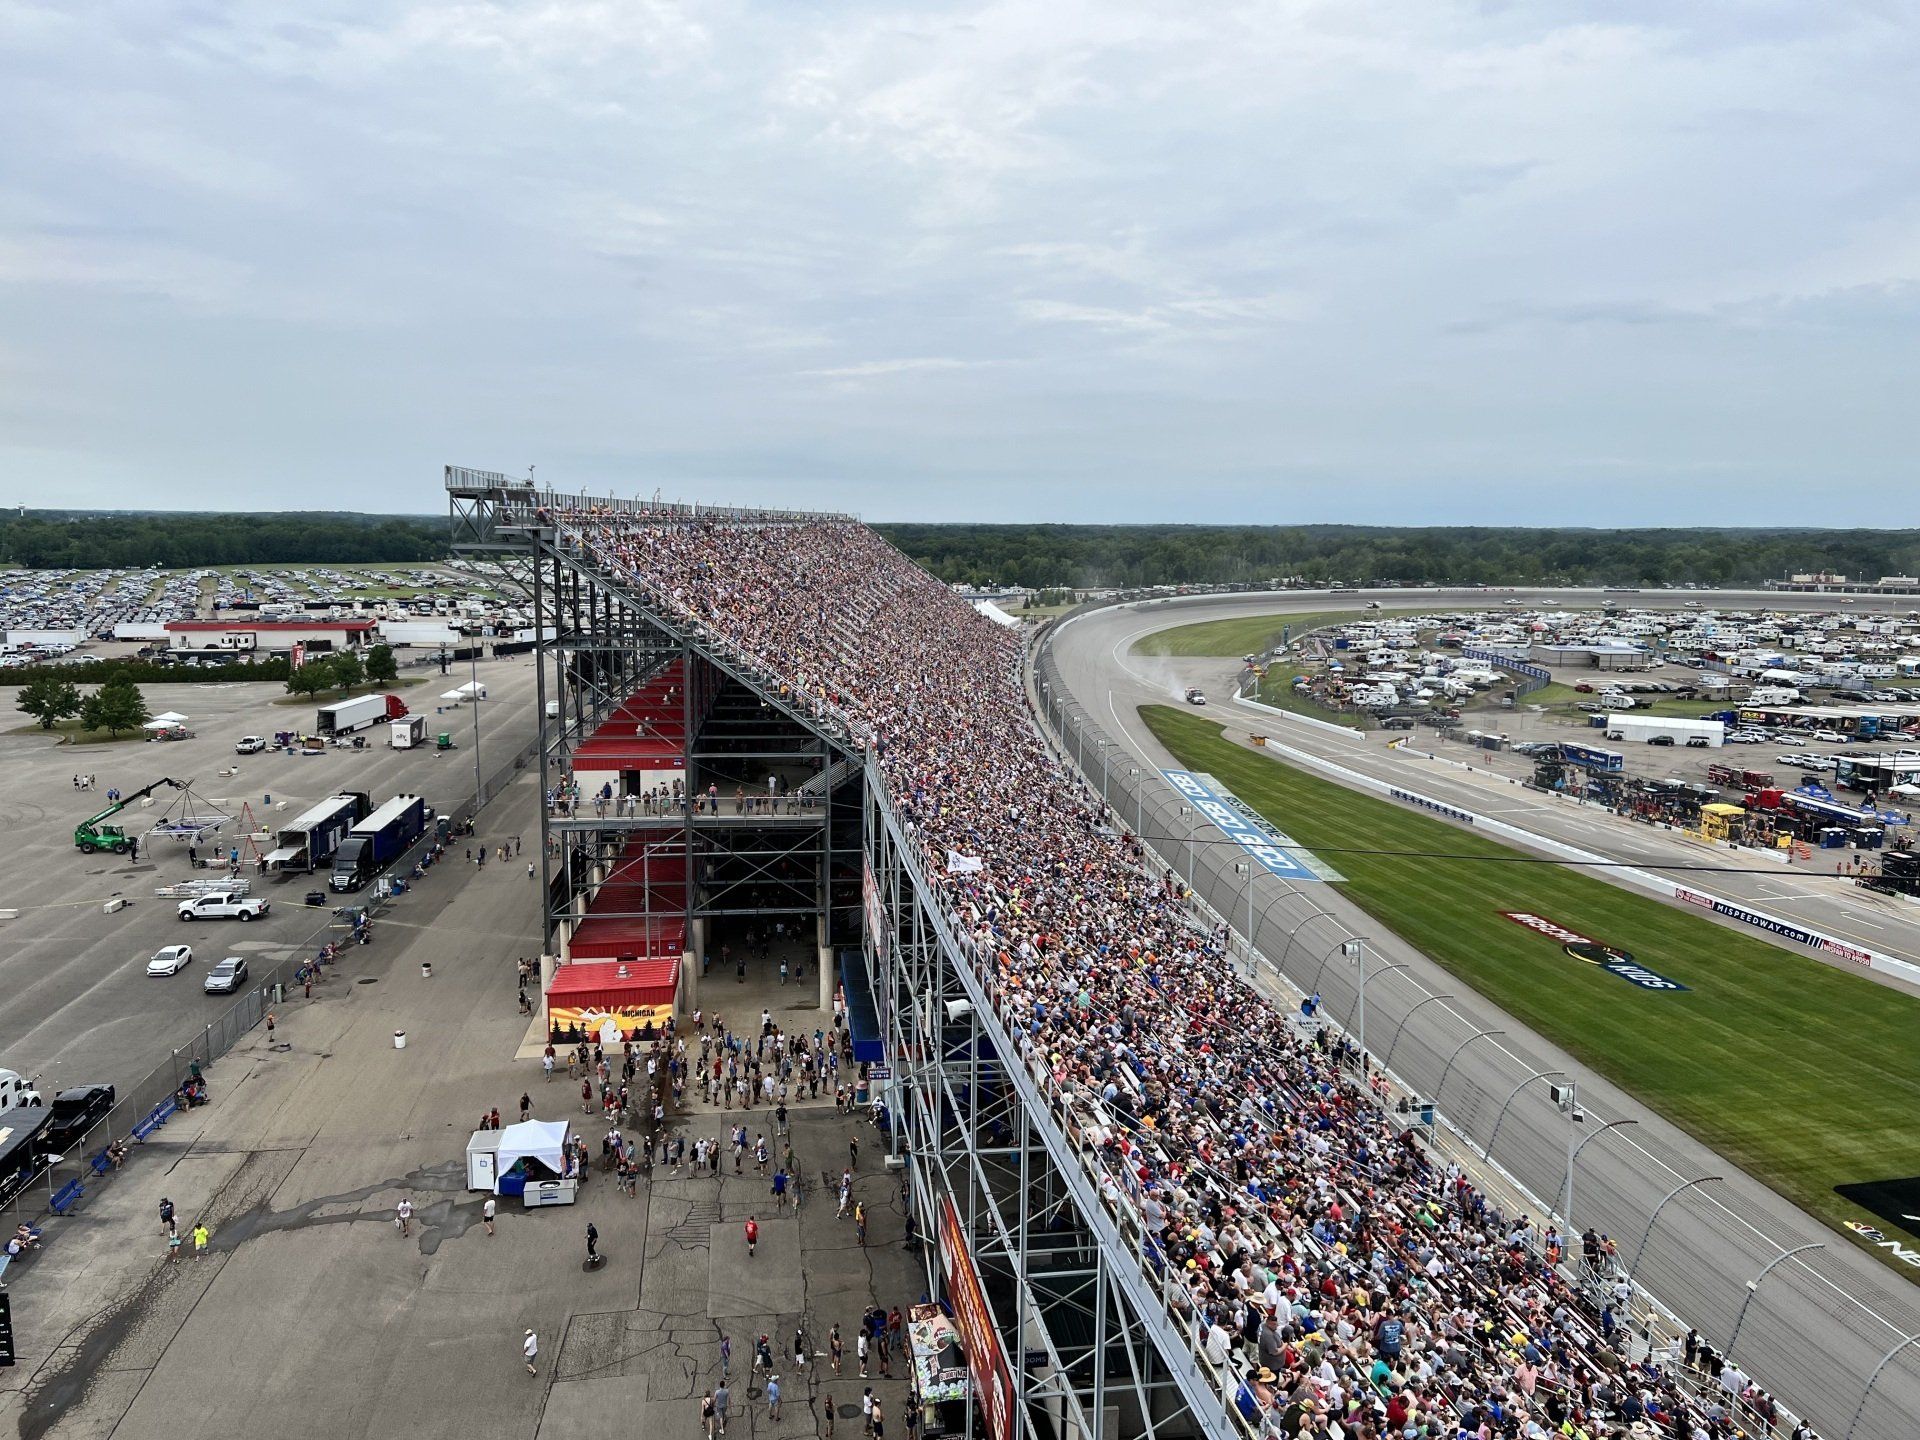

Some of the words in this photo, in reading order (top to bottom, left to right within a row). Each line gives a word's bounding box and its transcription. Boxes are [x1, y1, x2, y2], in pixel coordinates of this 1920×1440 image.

[1194, 800, 1247, 829] GEICO
[1506, 913, 1592, 944] NASCAR
[1716, 903, 1805, 941] MISPEEDWAY.com
[1852, 953, 1871, 966] 69050
[1608, 965, 1676, 989] KIDS
[622, 1009, 655, 1018] MICHIGAN
